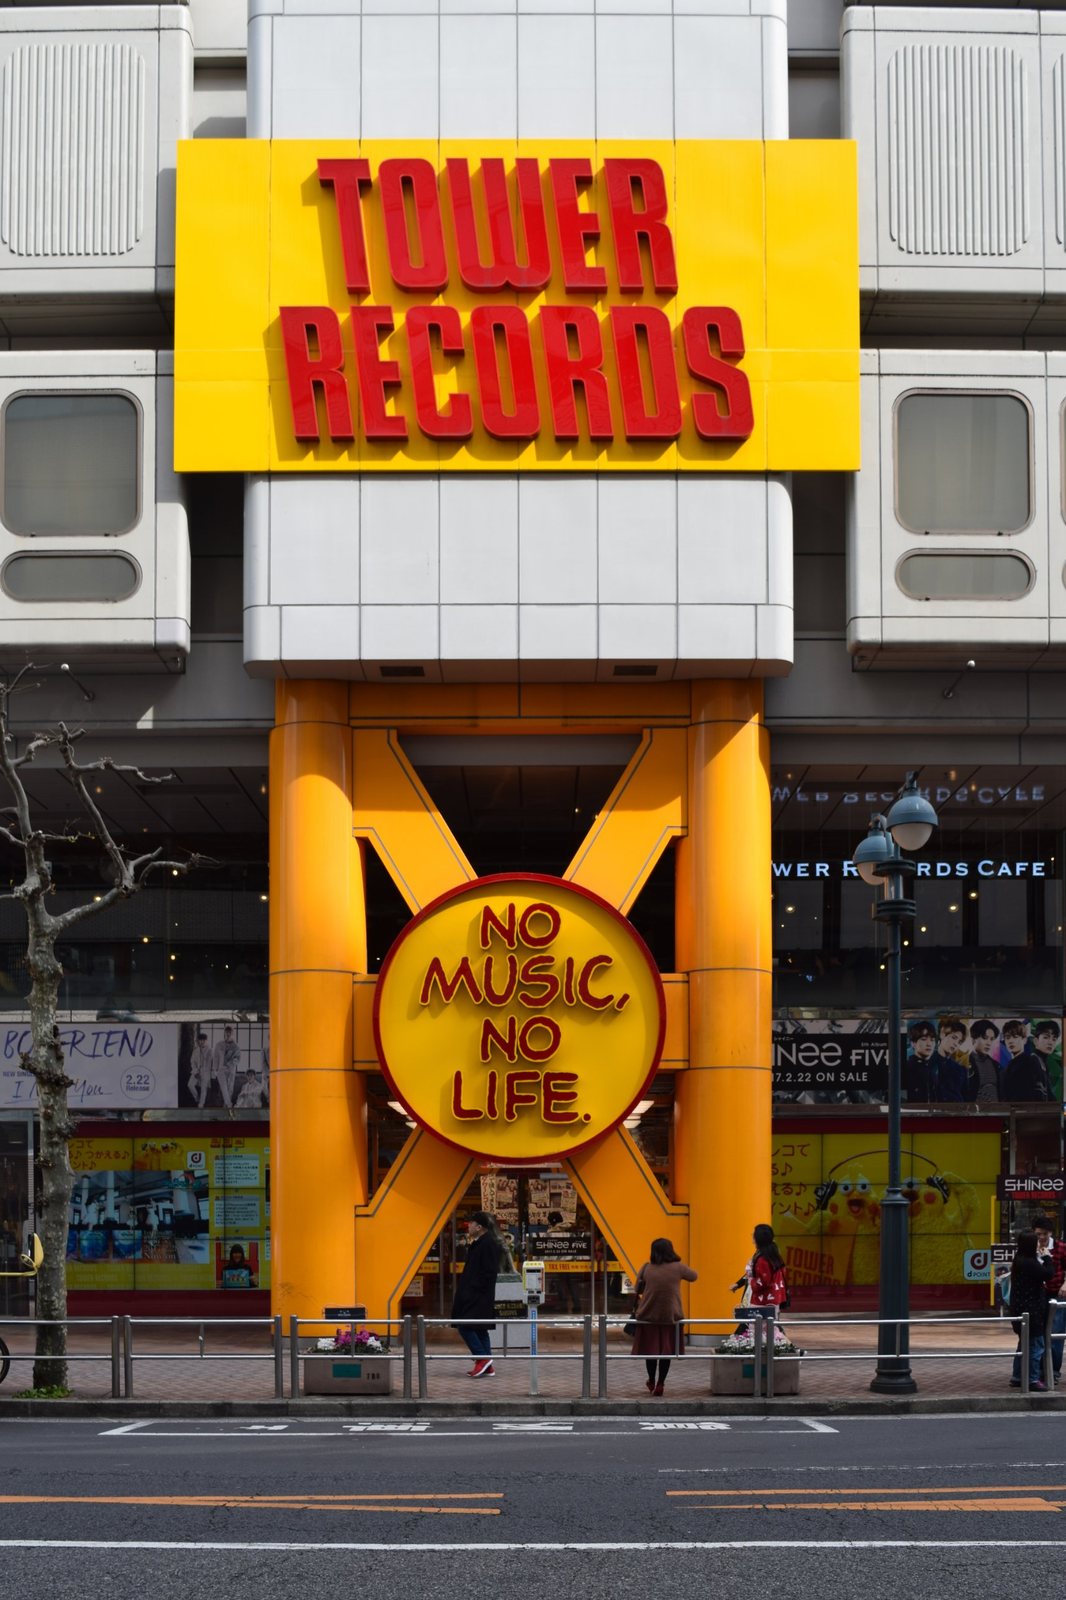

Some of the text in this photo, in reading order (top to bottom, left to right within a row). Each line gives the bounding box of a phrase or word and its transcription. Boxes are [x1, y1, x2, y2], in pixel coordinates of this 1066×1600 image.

[316, 158, 678, 295] TOWER
[278, 305, 755, 442] RECORDS
[977, 860, 1046, 877] CAFE
[480, 902, 562, 949] NO
[419, 954, 631, 1011] MUSIC,
[4, 1027, 154, 1059] BOFRIEND
[480, 1015, 562, 1063] NO
[126, 1074, 150, 1085] 2.22
[452, 1070, 592, 1124] LIFE.
[816, 1072, 835, 1082] ON
[840, 1072, 868, 1082] SALE
[785, 1246, 834, 1275] TOWER
